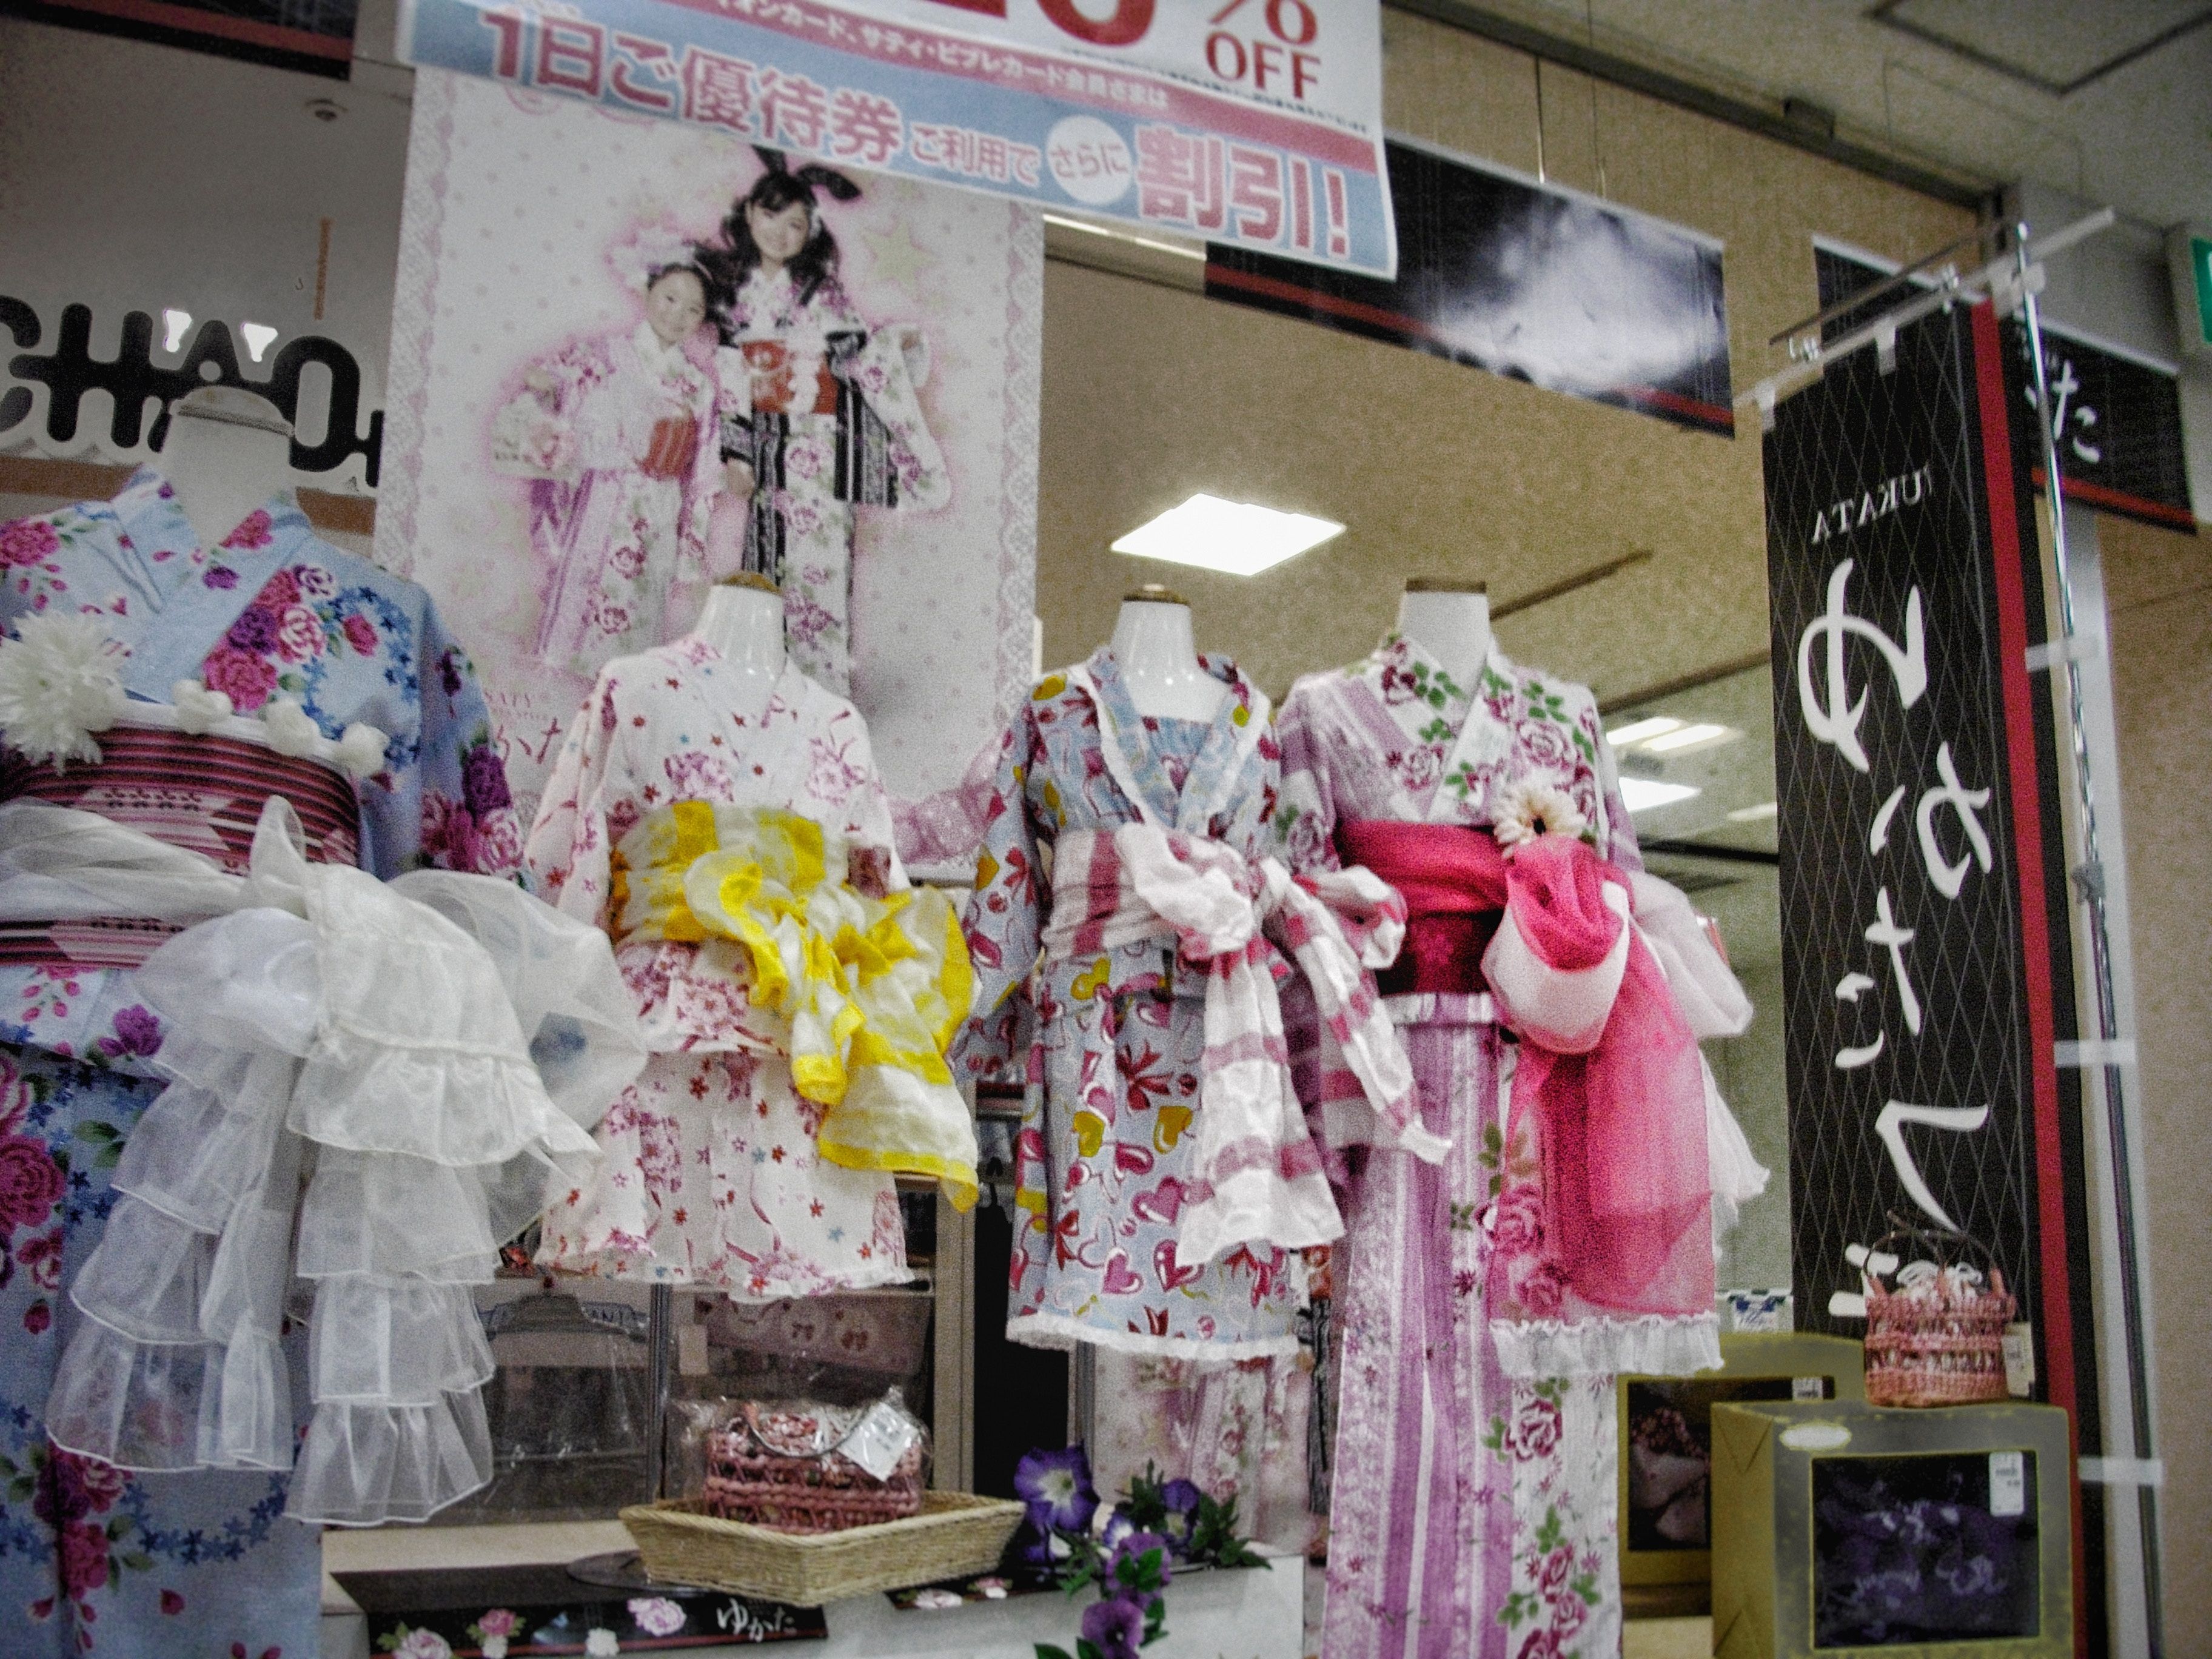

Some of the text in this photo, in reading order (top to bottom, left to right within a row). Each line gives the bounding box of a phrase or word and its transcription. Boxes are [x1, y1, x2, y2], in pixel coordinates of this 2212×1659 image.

[481, 10, 902, 165] 1日ご優待券
[911, 122, 1041, 187] ご利用で
[1048, 141, 1130, 179] さらに
[1205, 30, 1321, 99] OFF
[716, 1597, 799, 1643] ゆかた
